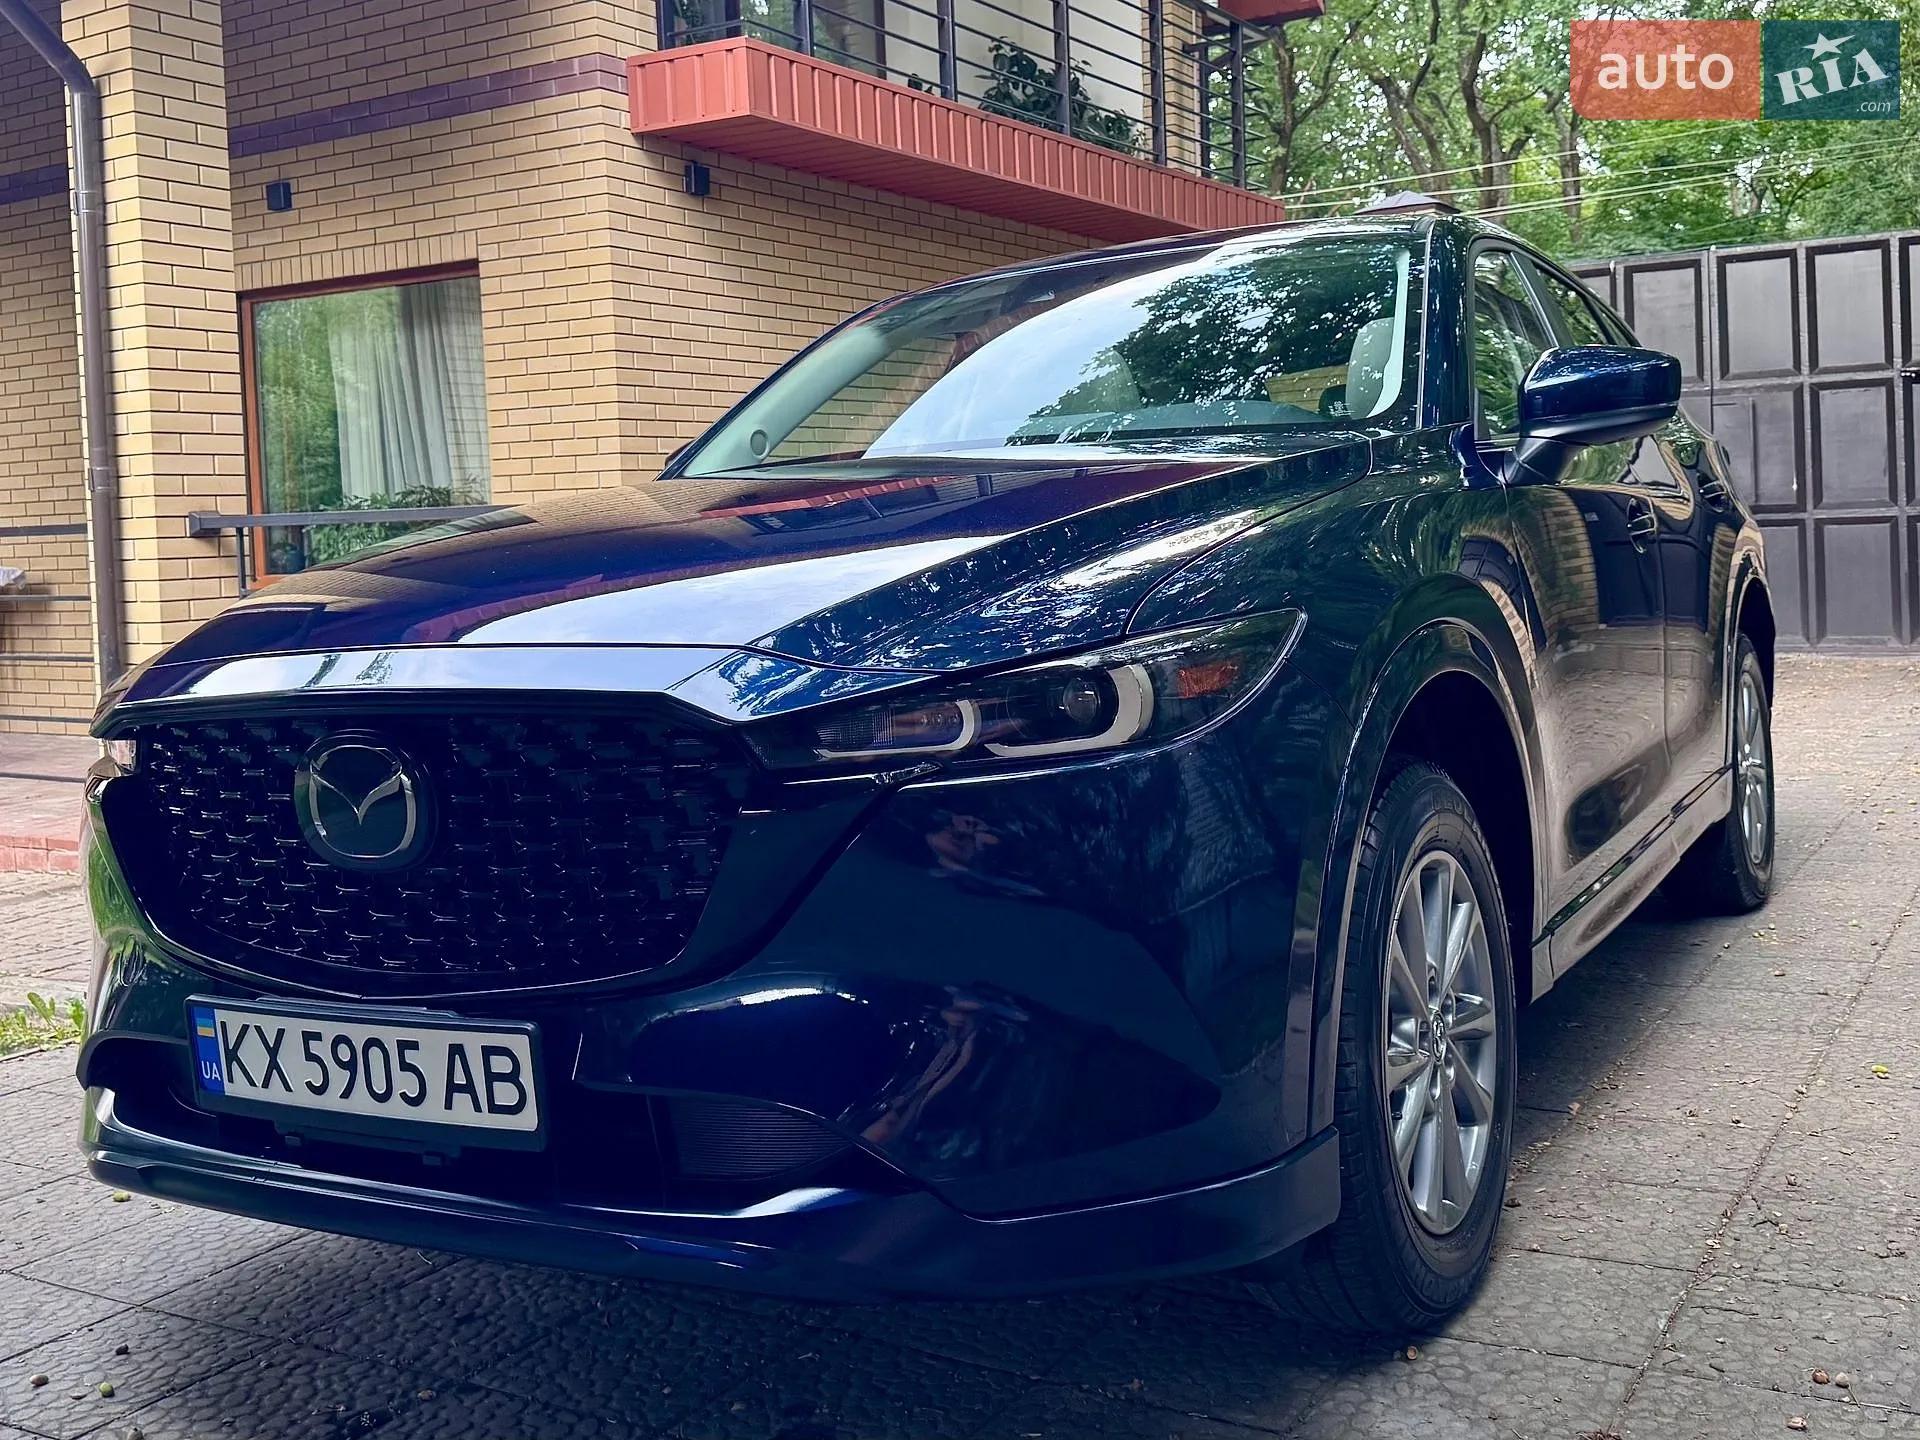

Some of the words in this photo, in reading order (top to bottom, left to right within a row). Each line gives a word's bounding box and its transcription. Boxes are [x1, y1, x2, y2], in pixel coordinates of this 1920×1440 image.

[202, 1060, 221, 1082] UA
[220, 1020, 294, 1093] KX
[301, 1030, 428, 1108] 5905
[443, 1043, 527, 1116] AB
